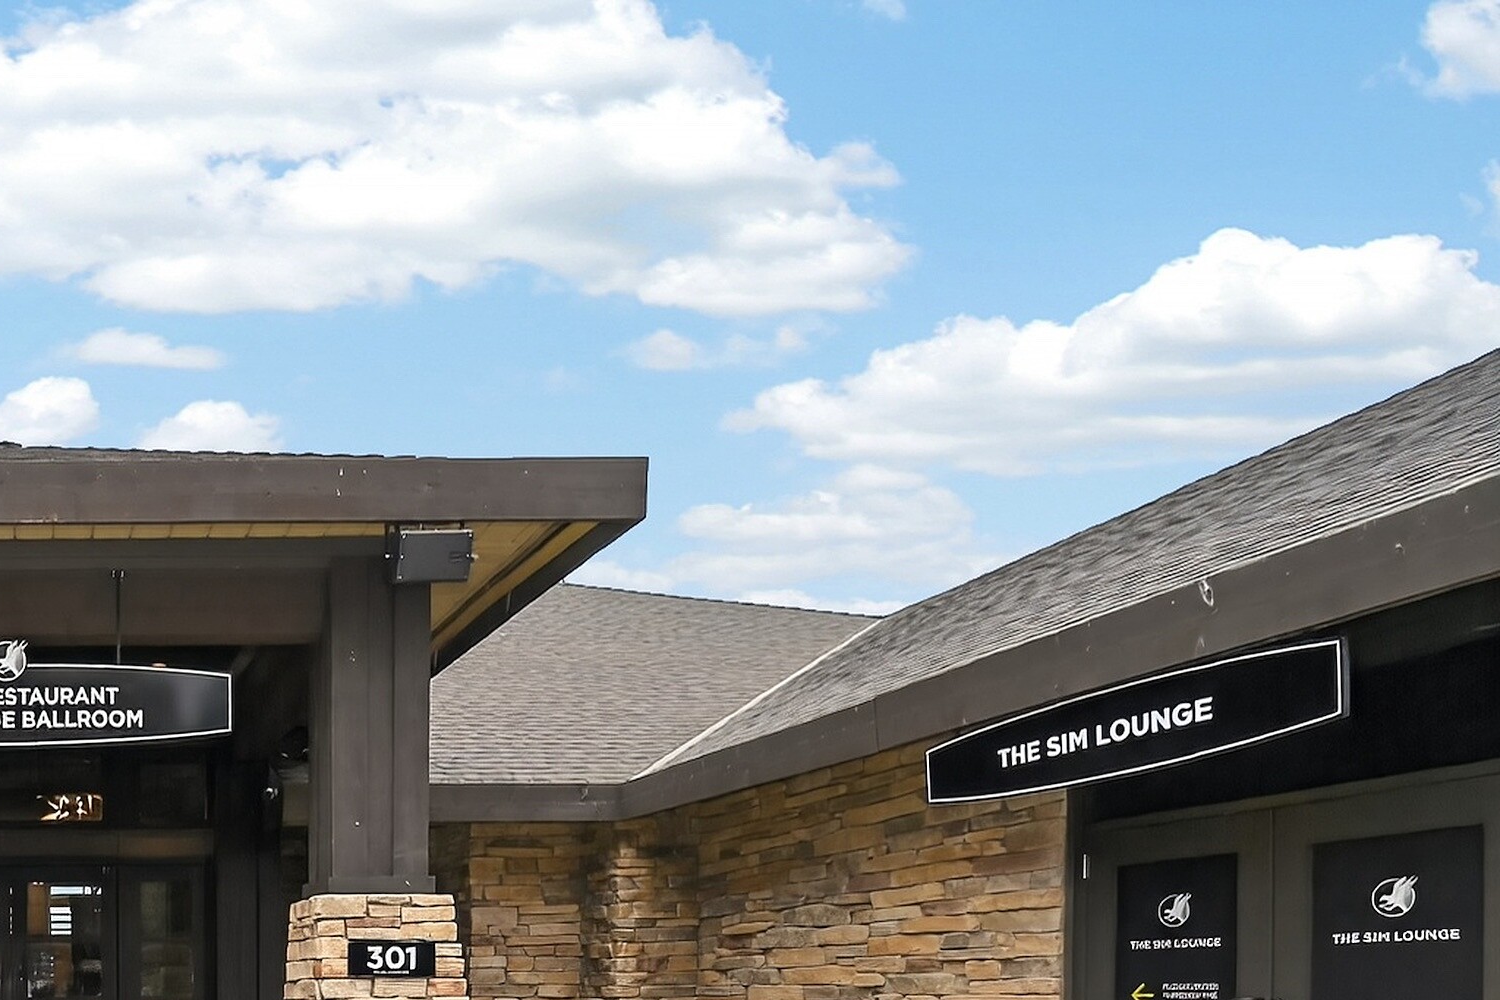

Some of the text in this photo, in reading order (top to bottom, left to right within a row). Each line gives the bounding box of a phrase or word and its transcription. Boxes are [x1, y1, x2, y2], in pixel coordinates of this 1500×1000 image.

[21, 709, 144, 729] BALLROOM
[997, 696, 1214, 769] THE SIM LOUNGE
[1129, 939, 1152, 950] THE
[1173, 937, 1222, 949] LOUNGE
[1332, 932, 1360, 945] THE
[1394, 928, 1461, 942] LOUNGE
[366, 945, 417, 971] 301
